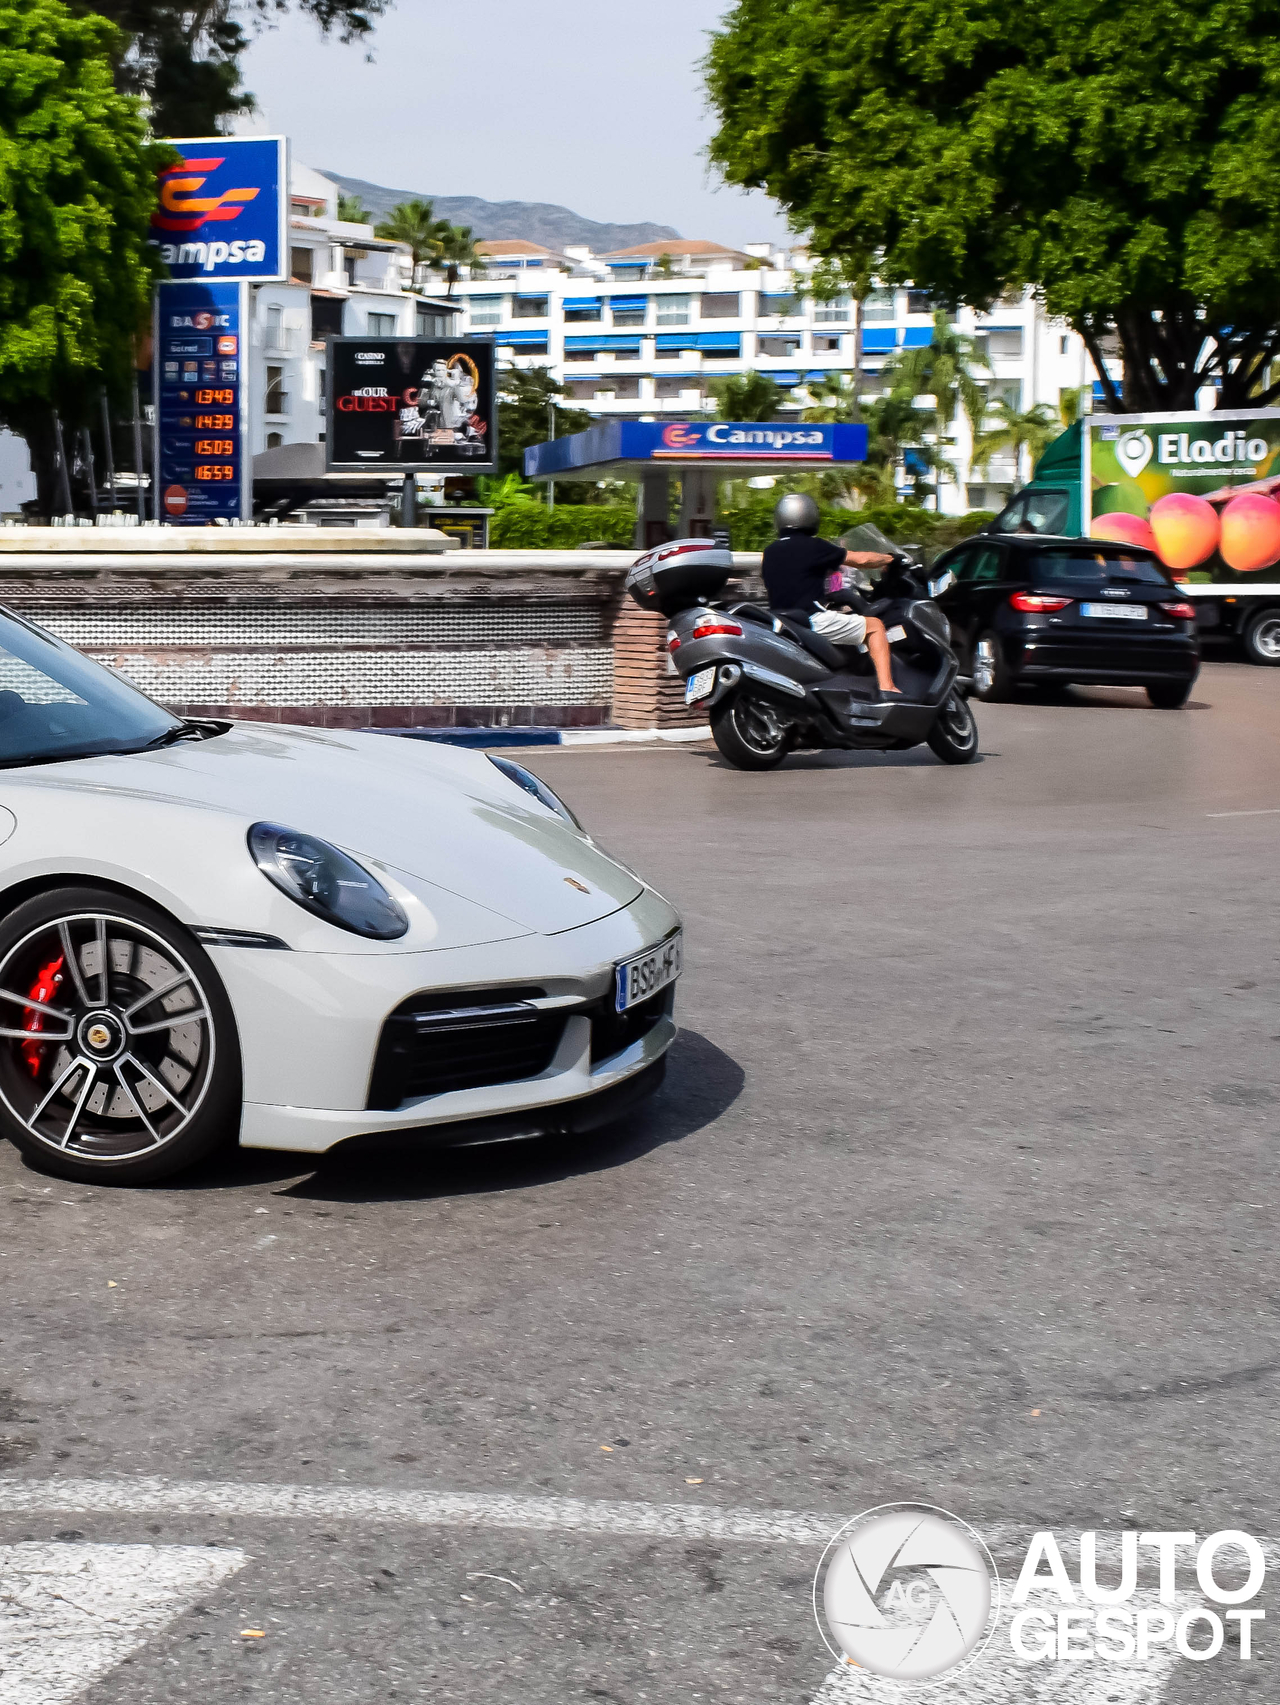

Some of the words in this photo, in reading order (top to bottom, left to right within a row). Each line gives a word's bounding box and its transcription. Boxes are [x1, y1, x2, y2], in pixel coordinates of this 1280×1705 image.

[170, 313, 230, 329] BASIC
[337, 395, 401, 412] GUEST
[706, 425, 824, 449] Campsa
[1158, 430, 1269, 464] Eladio
